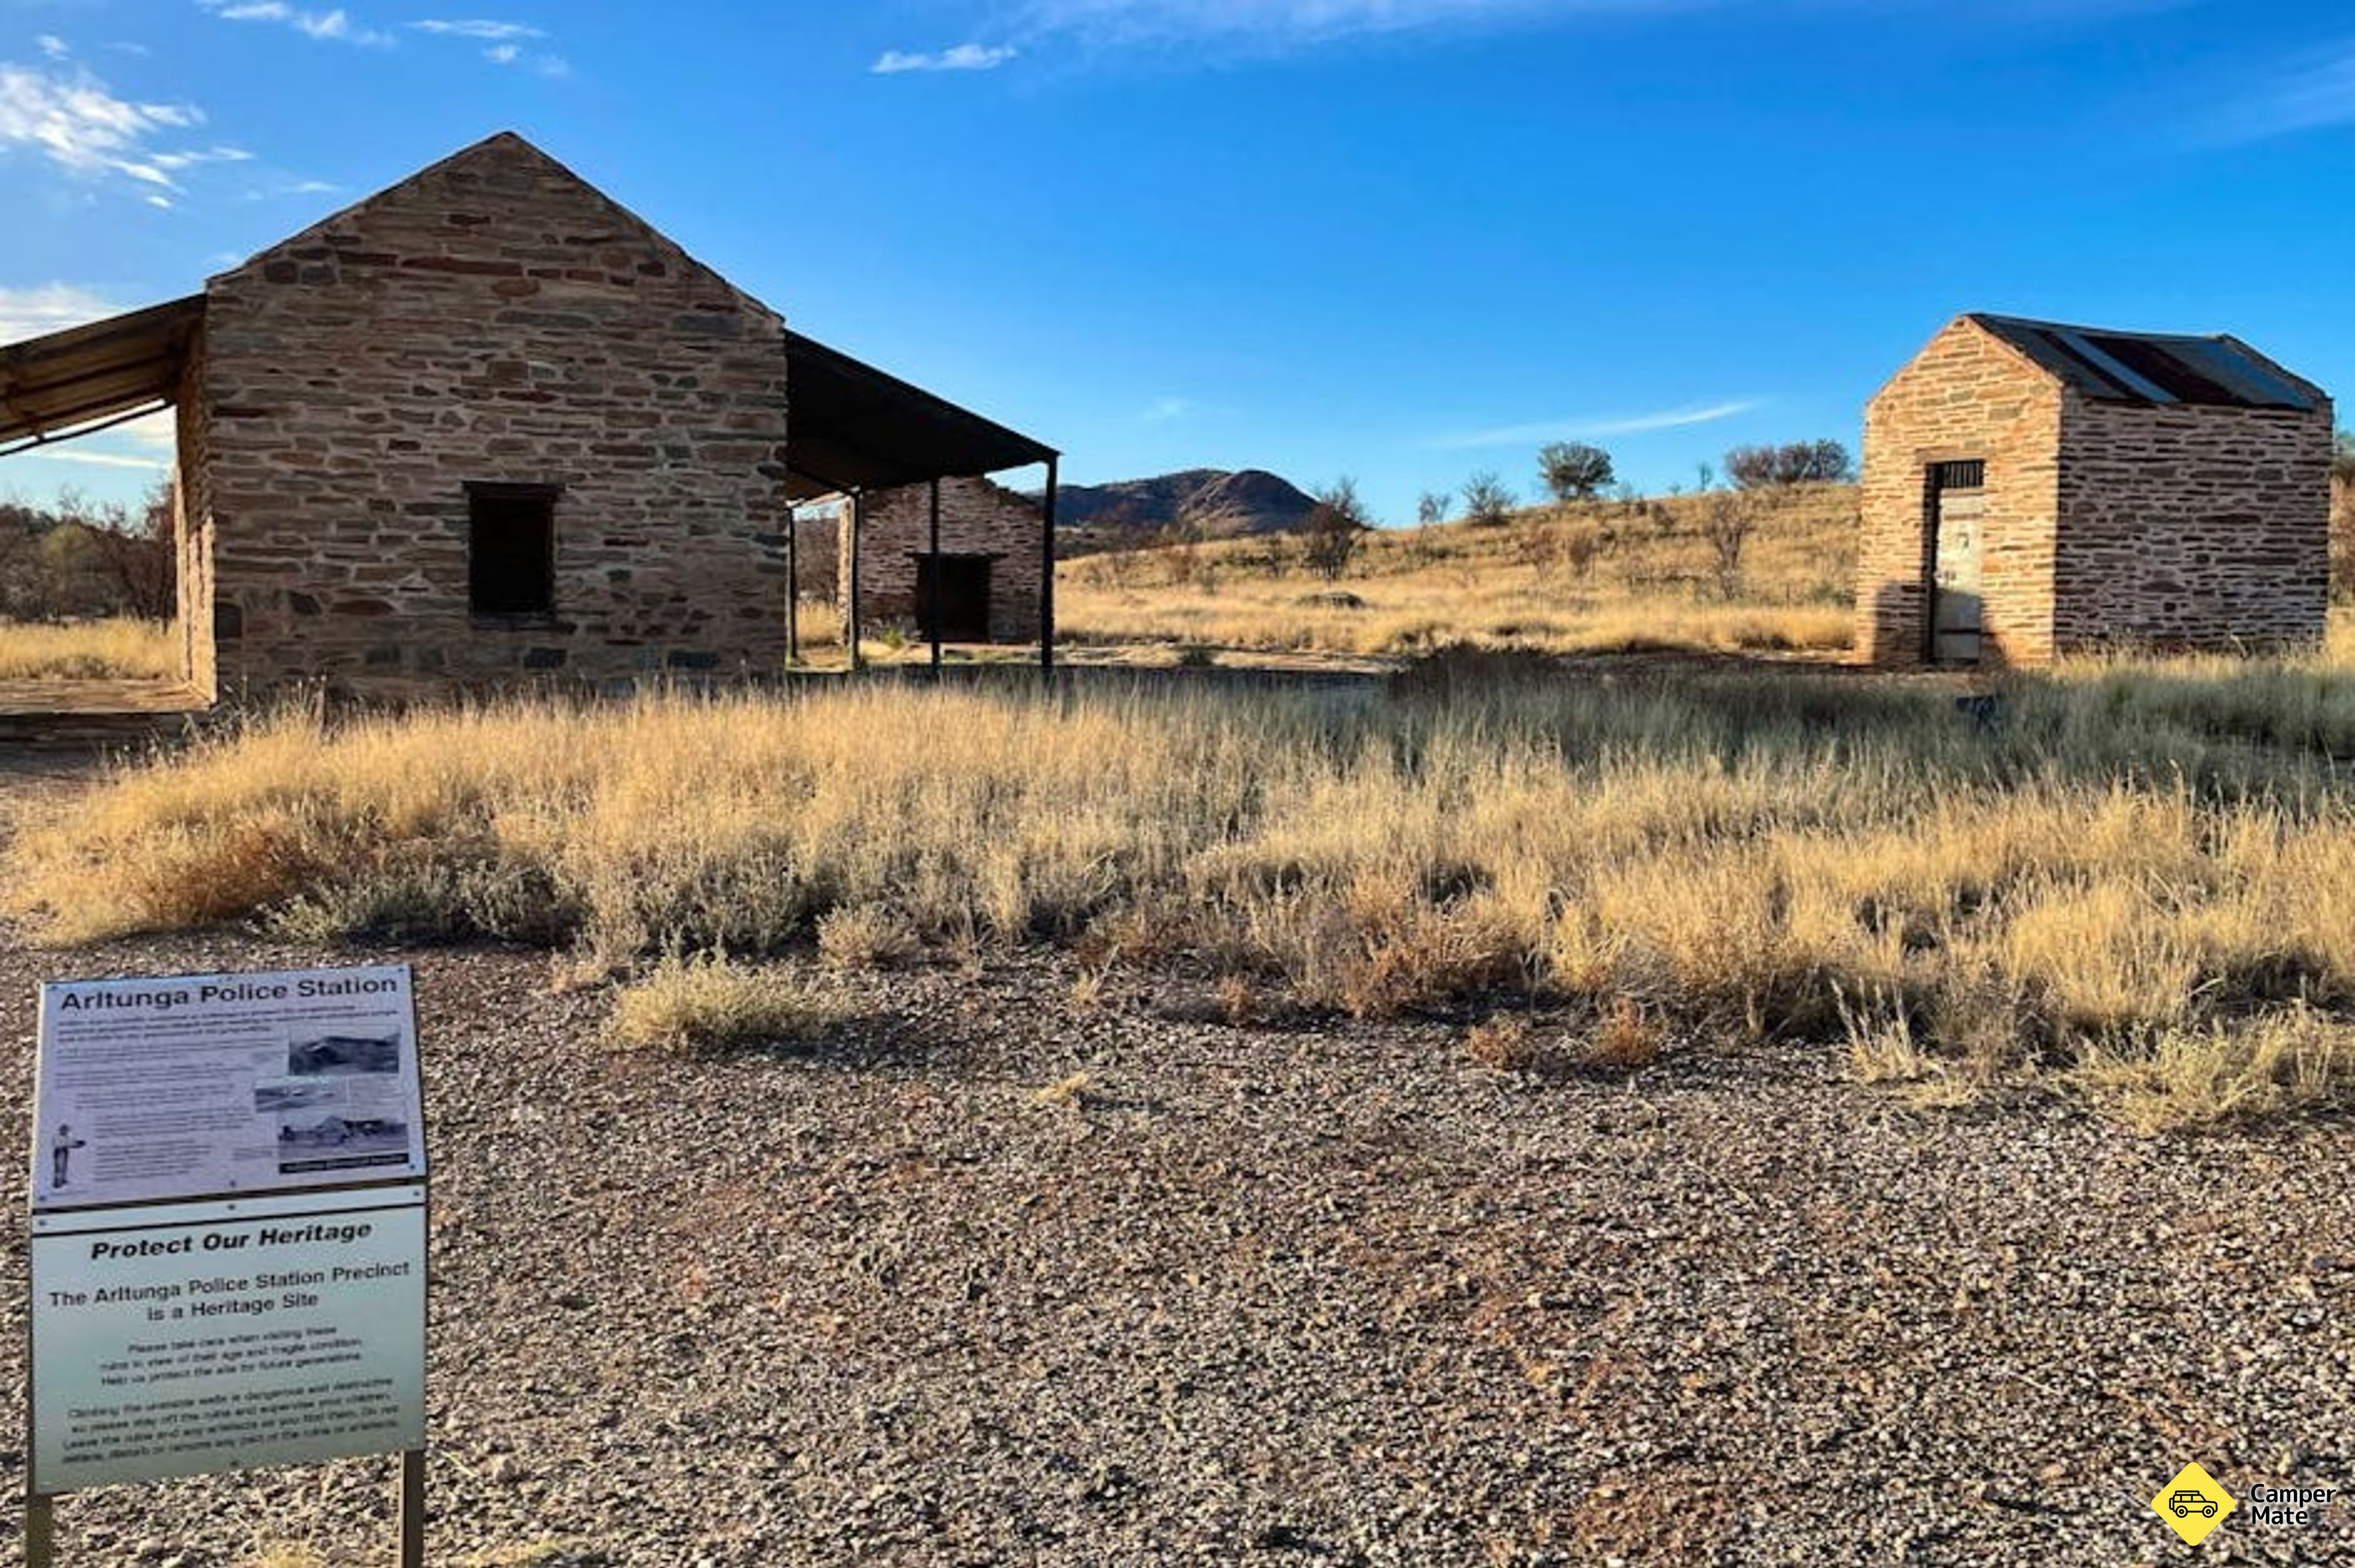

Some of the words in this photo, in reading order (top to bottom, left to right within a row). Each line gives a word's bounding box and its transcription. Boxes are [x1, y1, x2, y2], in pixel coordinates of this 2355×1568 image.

[62, 987, 190, 1011] Arltunga
[200, 982, 287, 1002] Police
[298, 976, 397, 998] Station
[91, 1236, 192, 1260] Protect
[203, 1233, 250, 1250] Our
[258, 1224, 373, 1245] Heritage
[50, 1291, 88, 1307] The
[94, 1284, 181, 1304] Arltunga
[189, 1277, 248, 1293] Police
[256, 1270, 324, 1288] Station
[332, 1262, 410, 1282] Precinct
[147, 1306, 165, 1321] is
[172, 1308, 184, 1319] a
[191, 1297, 275, 1316] Heritage
[283, 1292, 320, 1308] Site
